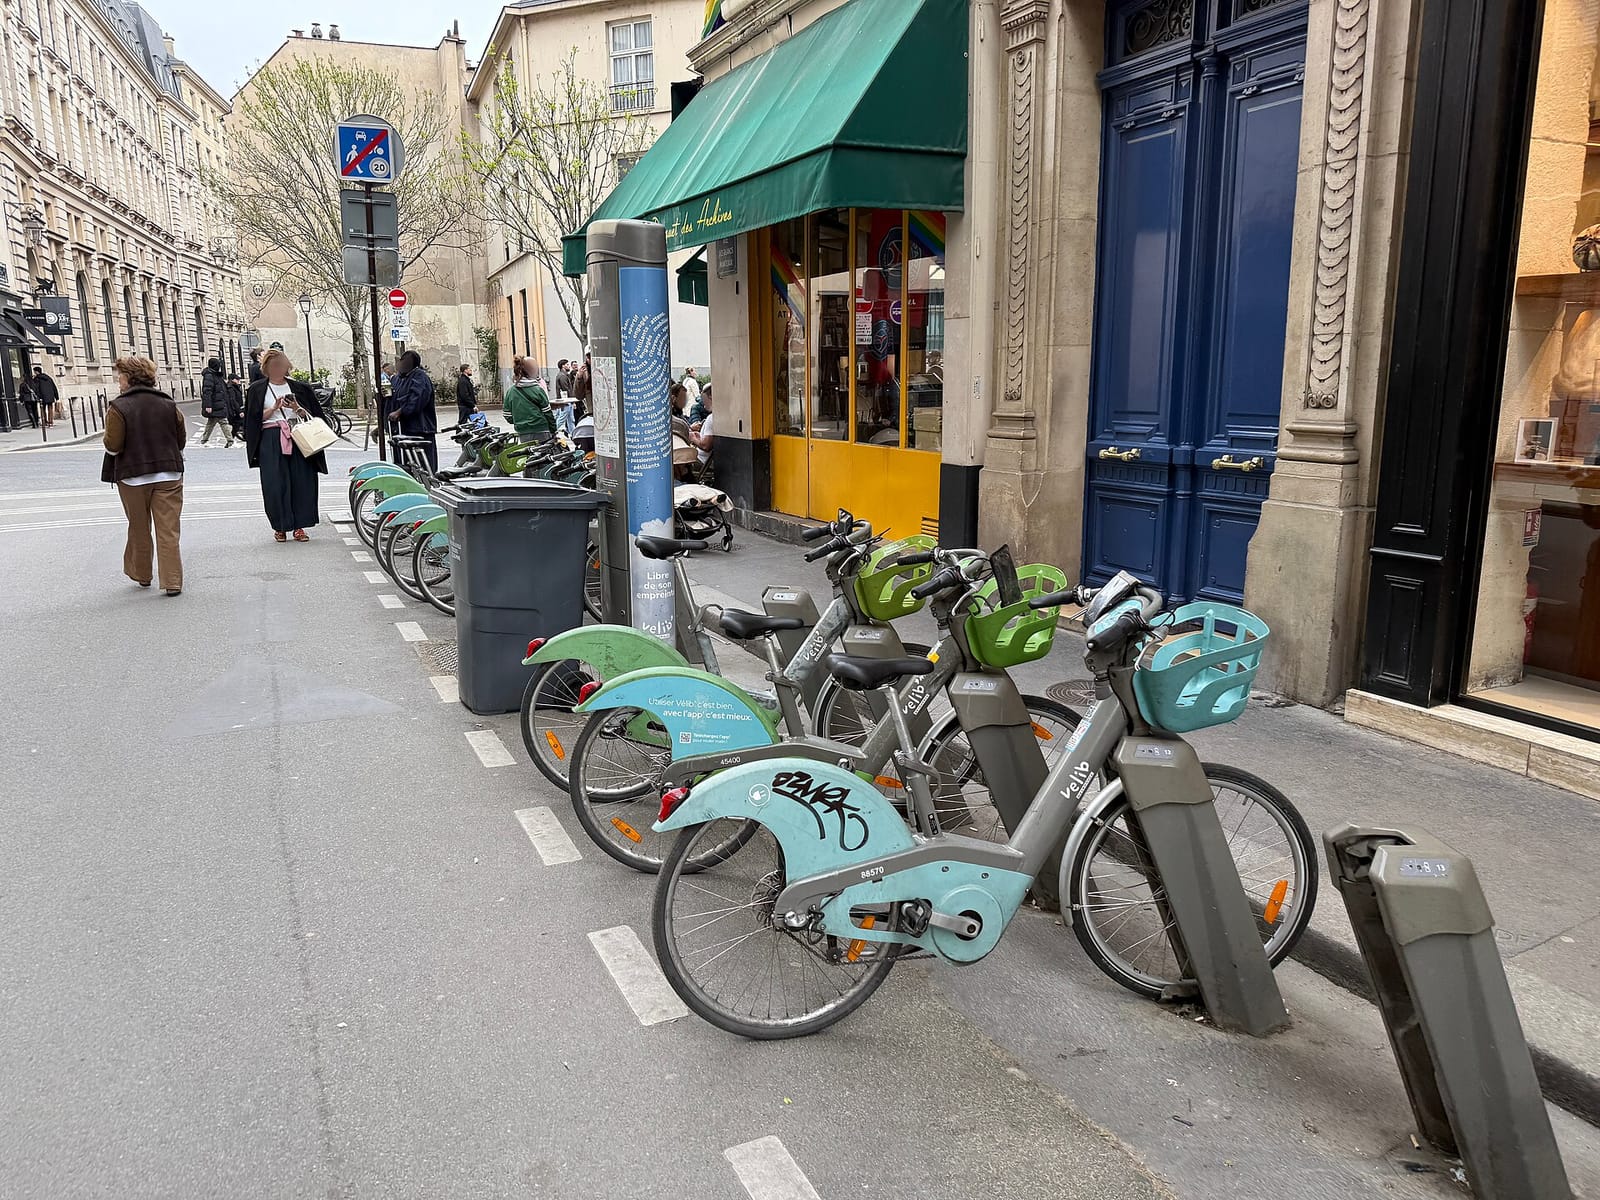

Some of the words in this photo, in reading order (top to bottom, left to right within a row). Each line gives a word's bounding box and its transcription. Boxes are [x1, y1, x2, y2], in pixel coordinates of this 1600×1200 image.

[373, 163, 386, 172] 20
[681, 212, 693, 234] des
[696, 197, 732, 231] Archives
[633, 327, 649, 356] pétillants
[628, 359, 648, 372] vivants
[630, 359, 658, 379] rayonnants
[627, 364, 662, 386] éco-conscients
[630, 383, 654, 393] attentifs
[631, 455, 660, 463] passionnés
[647, 571, 669, 580] Libre
[643, 582, 656, 590] de
[657, 581, 672, 590] son
[636, 589, 675, 600] empreint
[697, 700, 715, 709] c'est
[706, 711, 725, 720] c'est
[726, 712, 753, 721] mieux.
[720, 756, 741, 766] 45400
[860, 866, 885, 880] 88570
